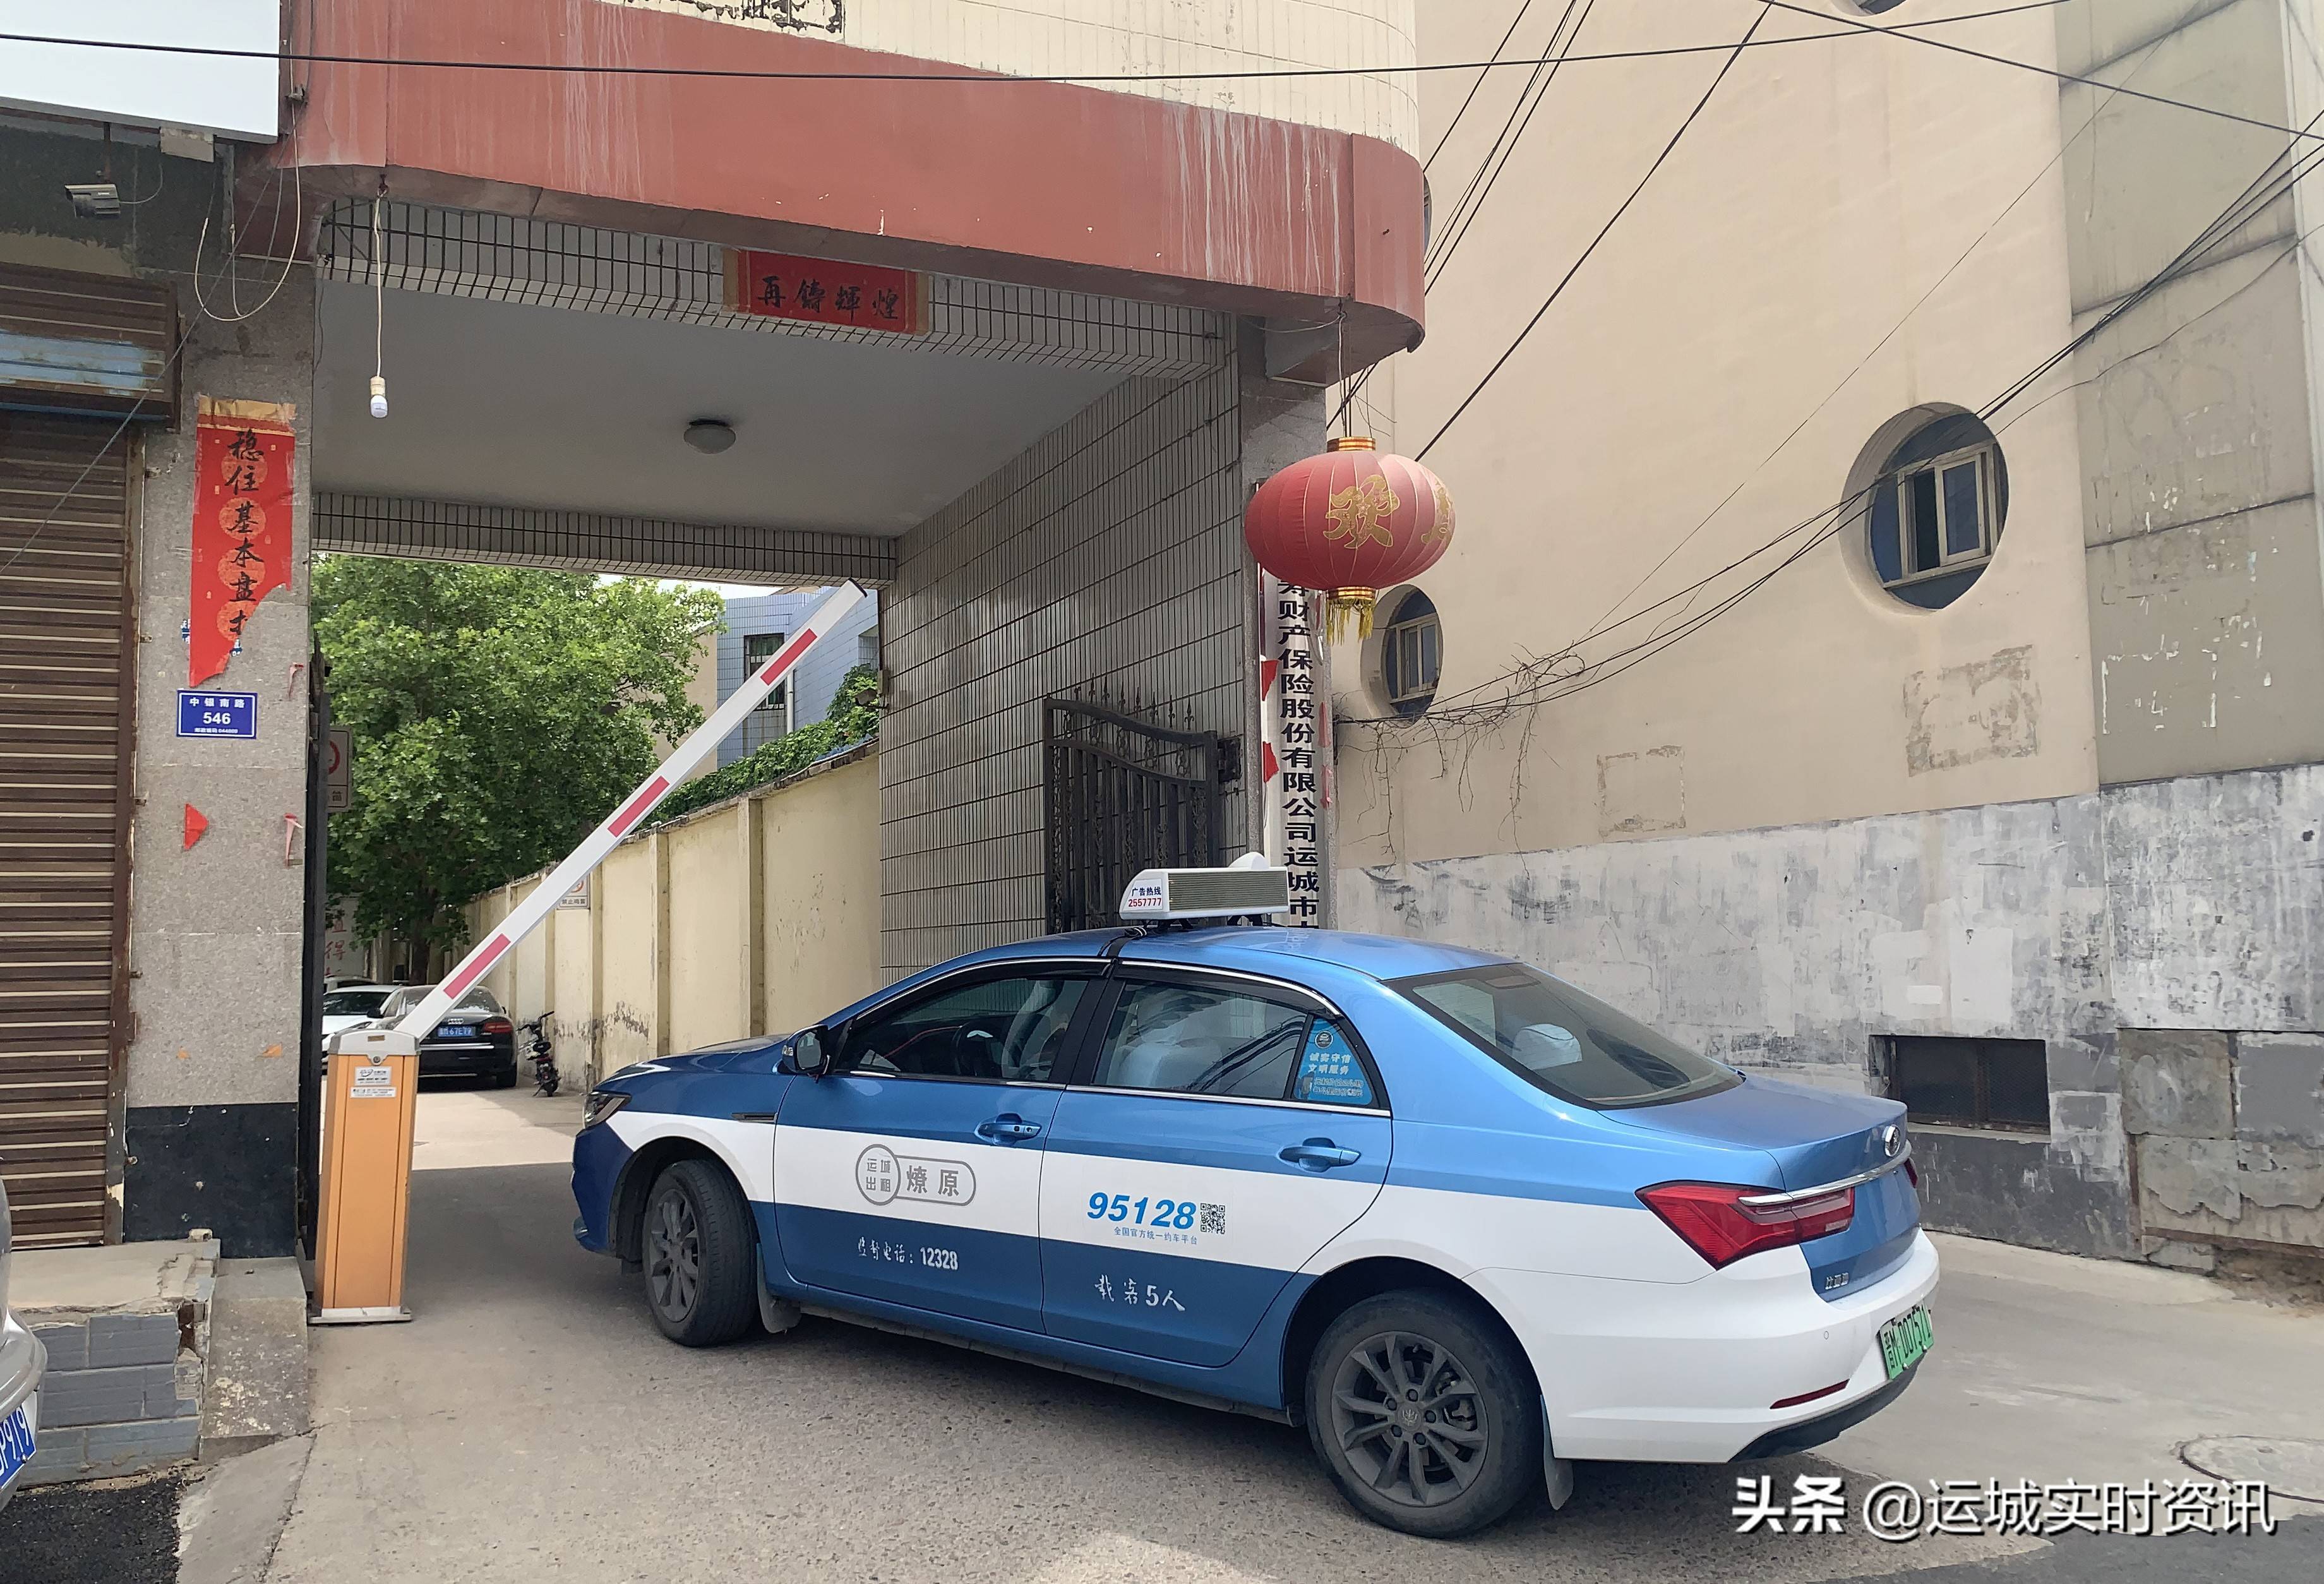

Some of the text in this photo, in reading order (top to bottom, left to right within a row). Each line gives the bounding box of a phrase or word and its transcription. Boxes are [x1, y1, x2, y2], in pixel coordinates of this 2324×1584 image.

[189, 697, 244, 708] 中银南路
[203, 712, 231, 724] 546
[1131, 885, 1162, 897] 广告热线
[1128, 897, 1163, 908] 2557777
[1309, 1064, 1349, 1075] 文明服务
[866, 1158, 891, 1173] 运城
[866, 1176, 891, 1192] 出租
[906, 1165, 959, 1197] 燎原
[1087, 1192, 1197, 1230] 95128
[1113, 1226, 1198, 1245] 全国官方统一约车平台
[1094, 1274, 1186, 1312] 载客5人
